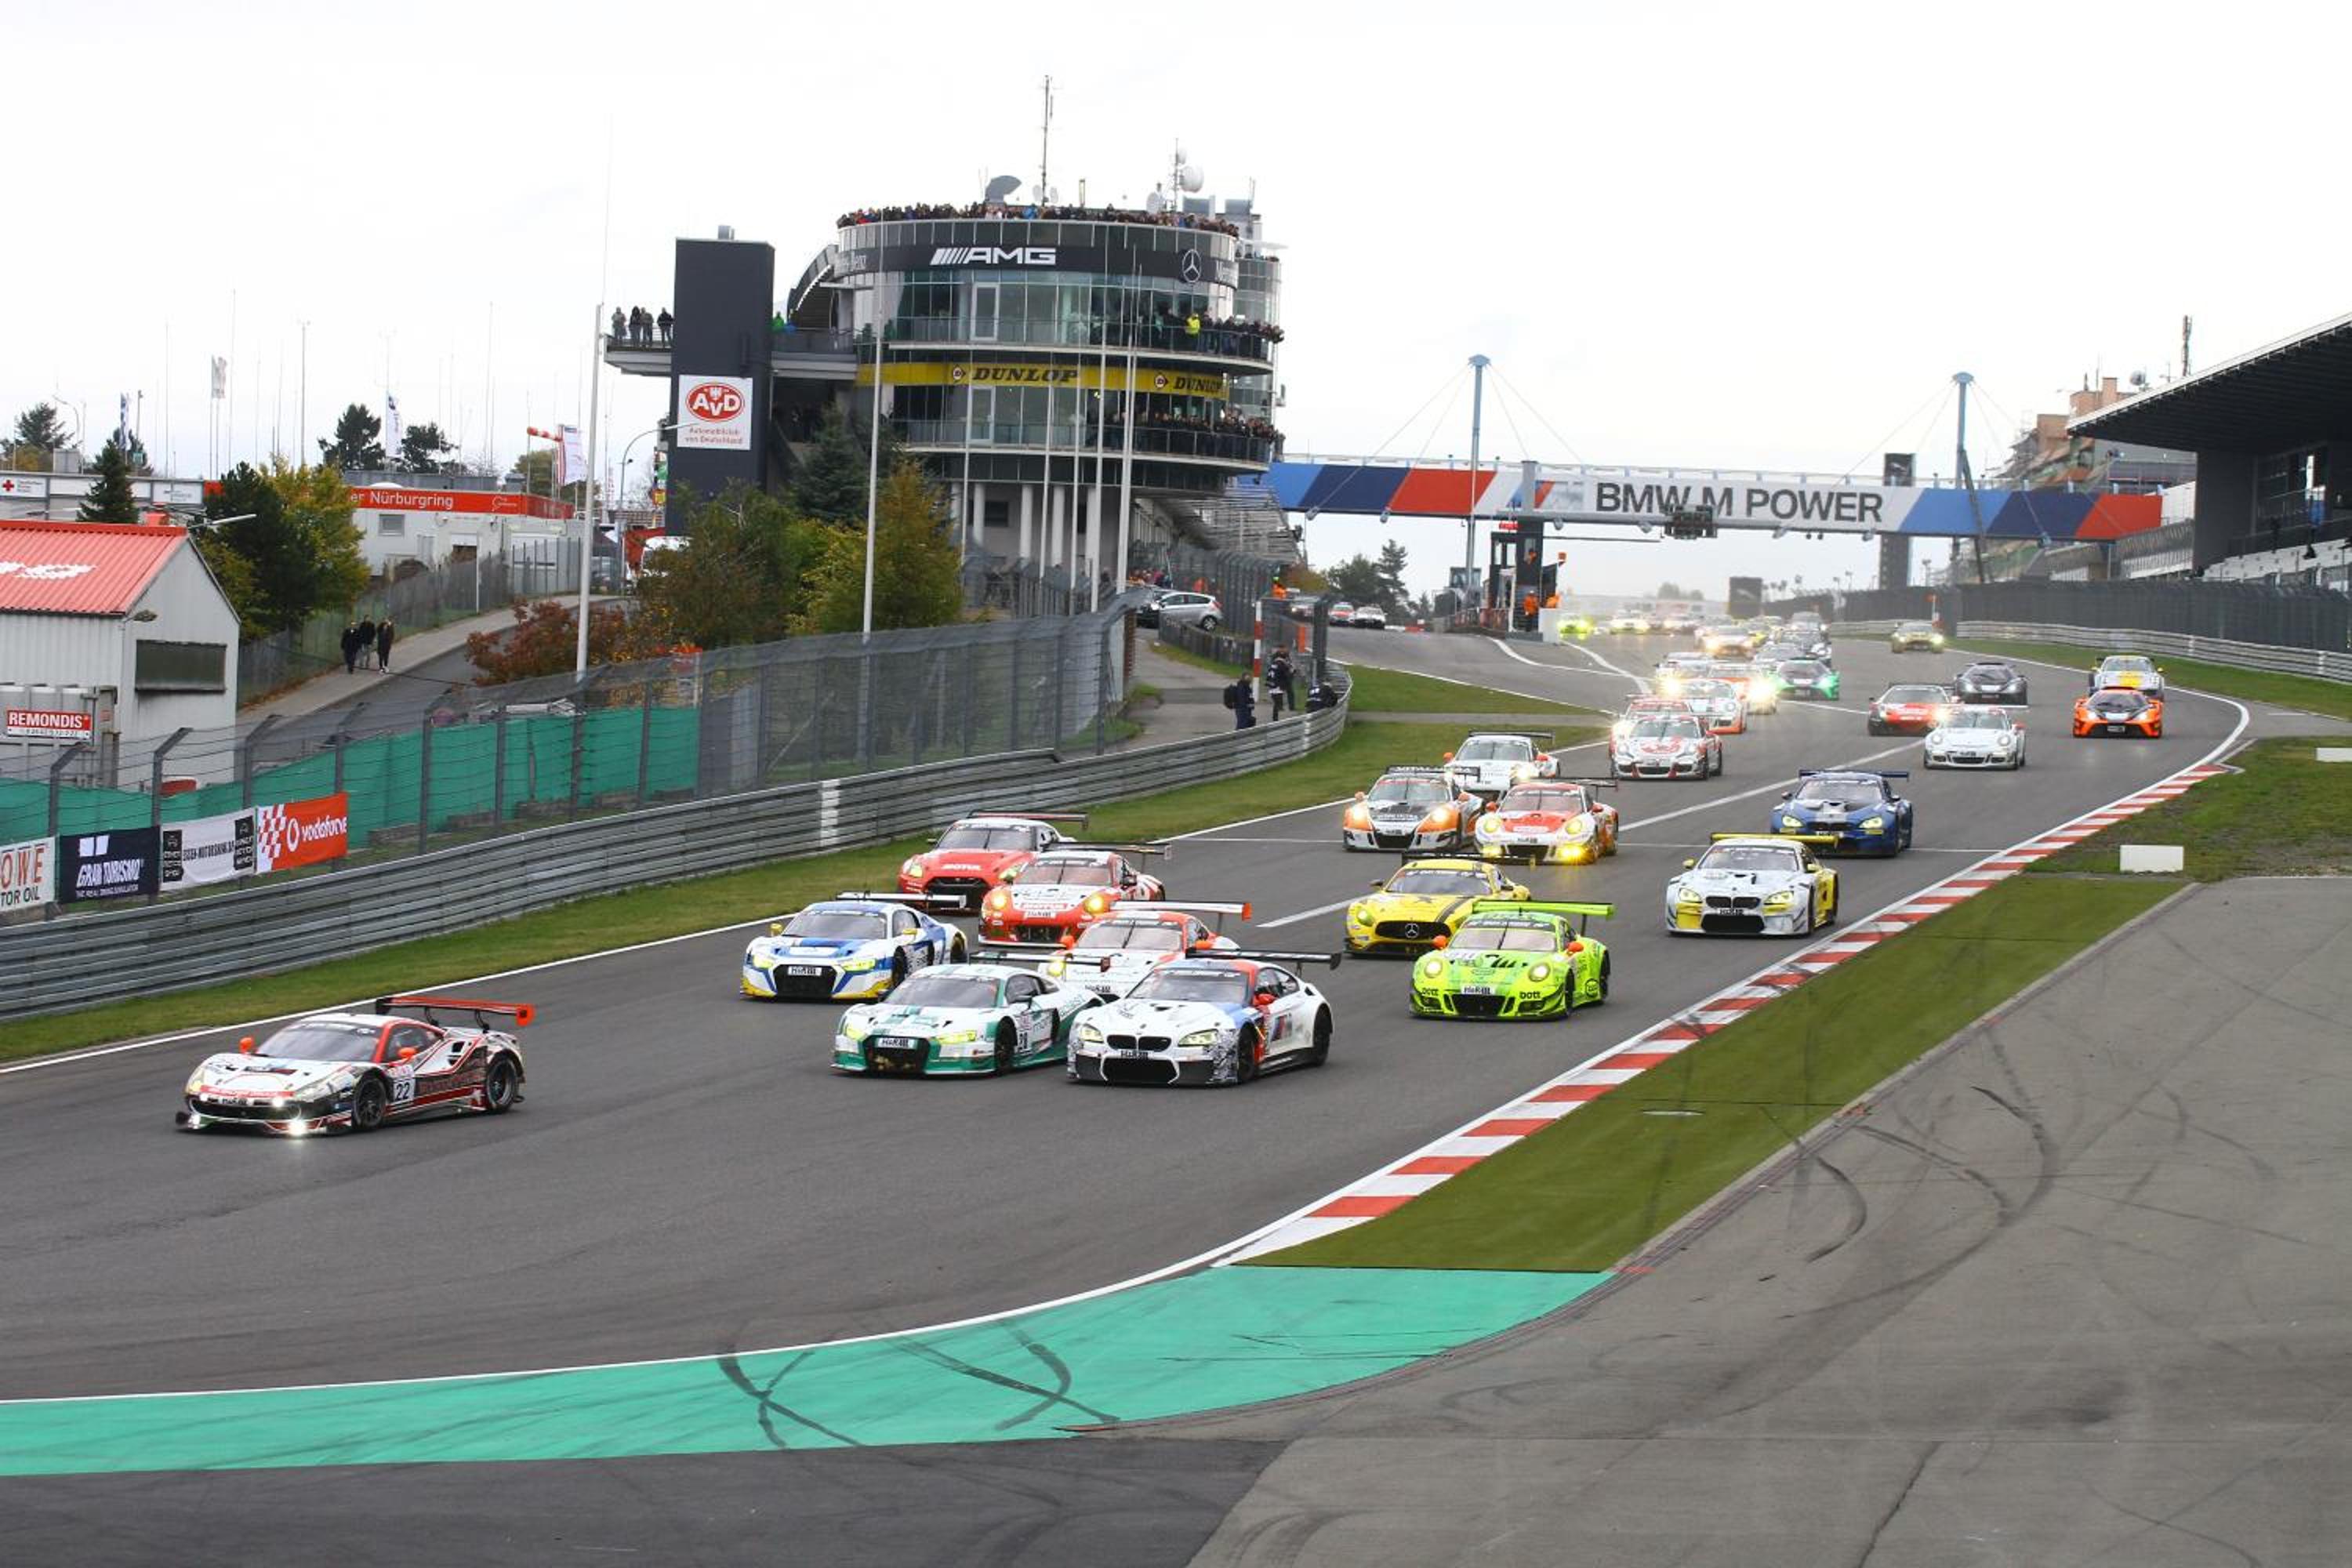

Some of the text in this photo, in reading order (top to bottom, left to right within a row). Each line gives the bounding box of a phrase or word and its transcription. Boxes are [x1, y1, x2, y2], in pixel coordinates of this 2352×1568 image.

[964, 247, 1057, 265] AMG
[972, 368, 1079, 383] DUNLOP
[370, 489, 454, 511] Nürburgring
[1595, 481, 1883, 523] BMW M POWER
[9, 711, 83, 728] REMONDIS
[301, 814, 348, 841] vodafone
[76, 858, 140, 887] GRAN TURISMO
[23, 886, 41, 902] OIL
[394, 1081, 410, 1101] 22
